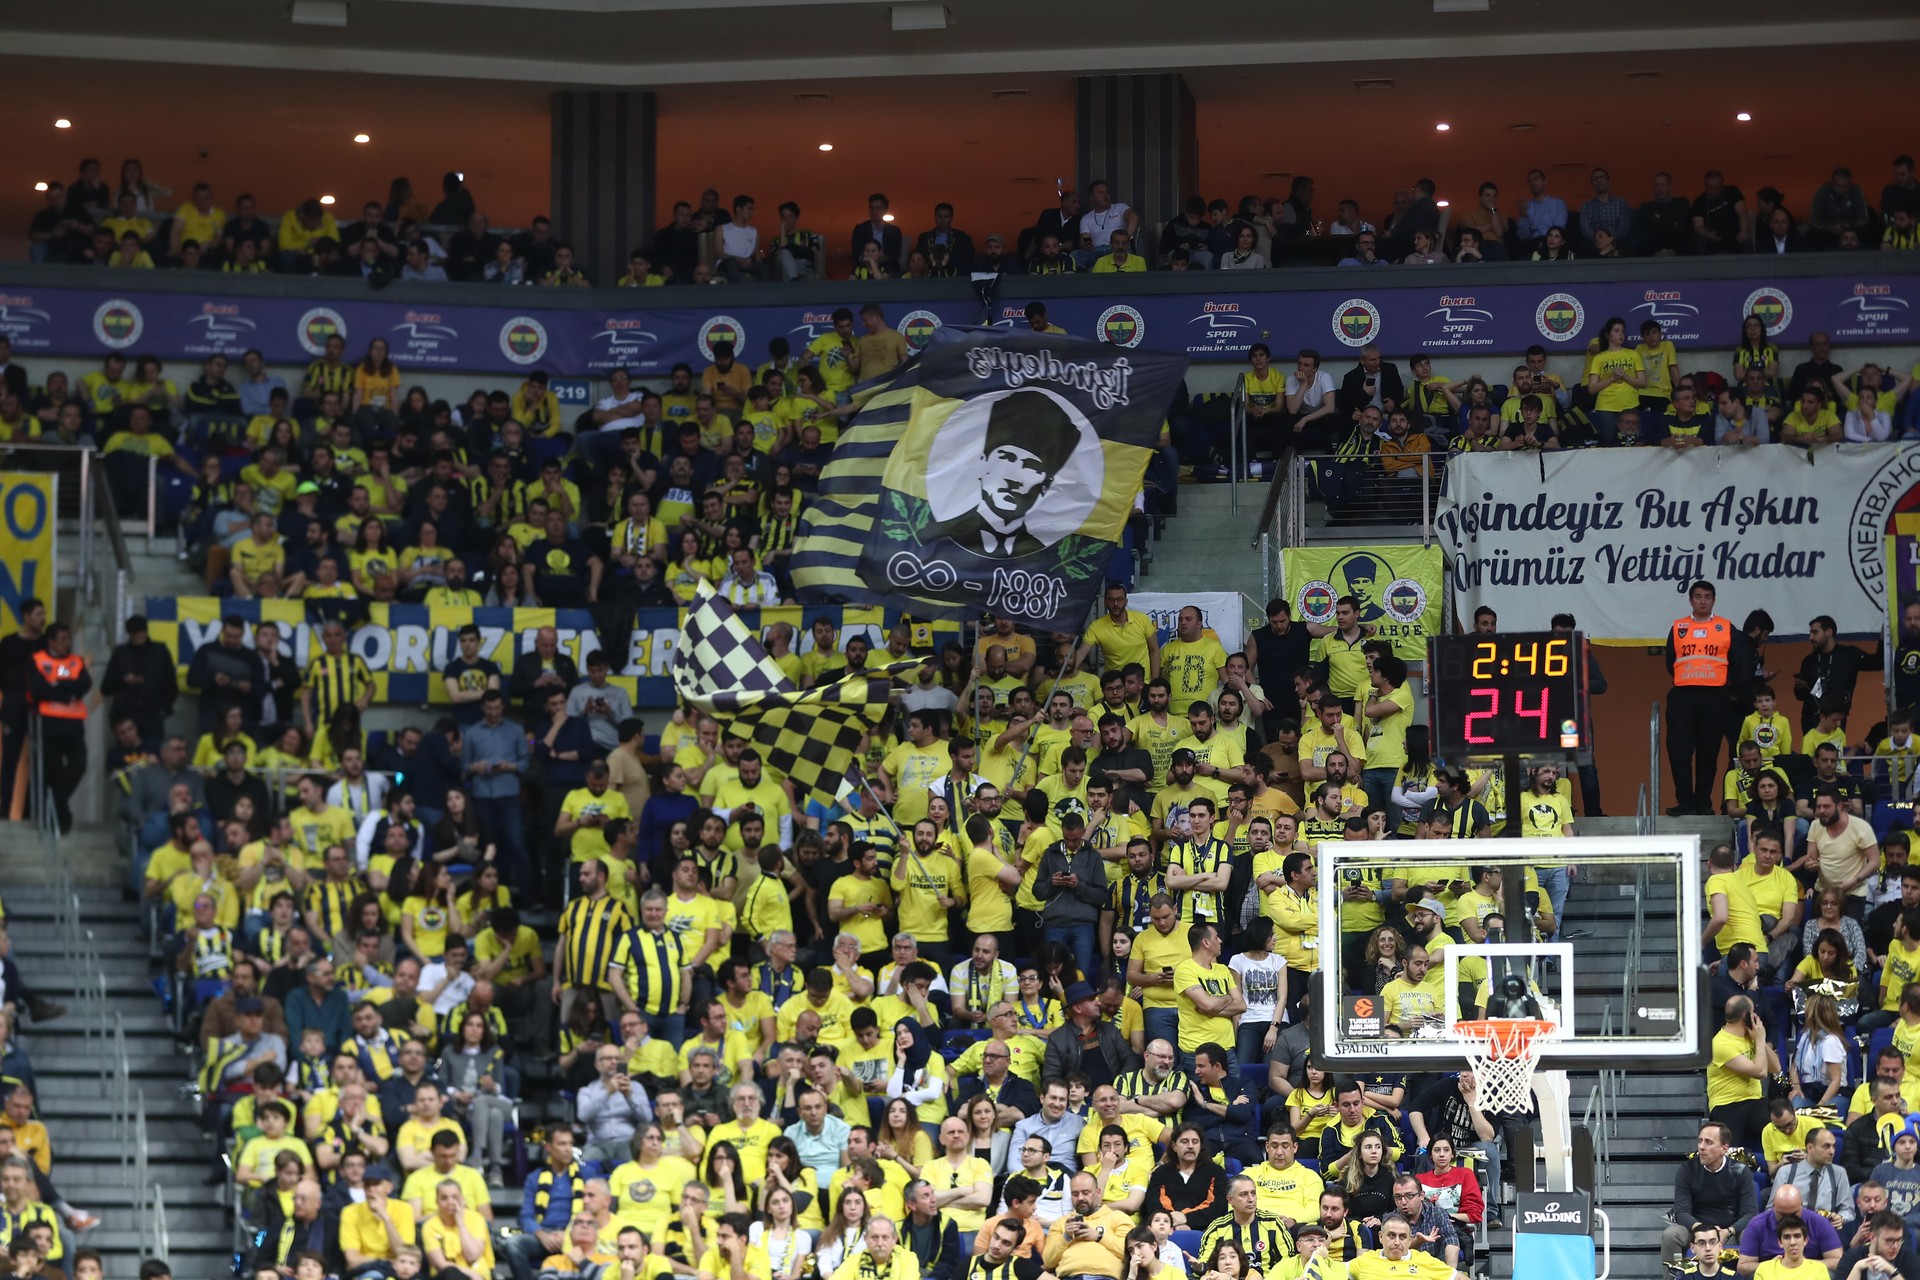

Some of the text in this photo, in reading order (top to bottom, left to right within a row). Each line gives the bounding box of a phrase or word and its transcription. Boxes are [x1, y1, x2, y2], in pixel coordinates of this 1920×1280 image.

[1440, 295, 1476, 307] ÜLKER
[1644, 289, 1681, 302] ÜLKER
[1002, 306, 1027, 318] ÜLK
[1203, 301, 1239, 313] ÜLKER
[1856, 312, 1889, 322] SPOR
[1206, 330, 1237, 339] SPOR
[1442, 324, 1474, 333] SPOR
[555, 385, 586, 400] 219
[1635, 488, 1691, 530] Bu
[1700, 485, 1819, 535] Aşkın
[1595, 543, 1705, 594] Yettiği
[1712, 540, 1826, 581] Kadar
[1681, 643, 1719, 657] 237 101
[1472, 639, 1568, 679] 2:46
[1464, 687, 1549, 744] 24
[1335, 1043, 1388, 1055] SPALDING
[1524, 1210, 1582, 1224] SPALDING
